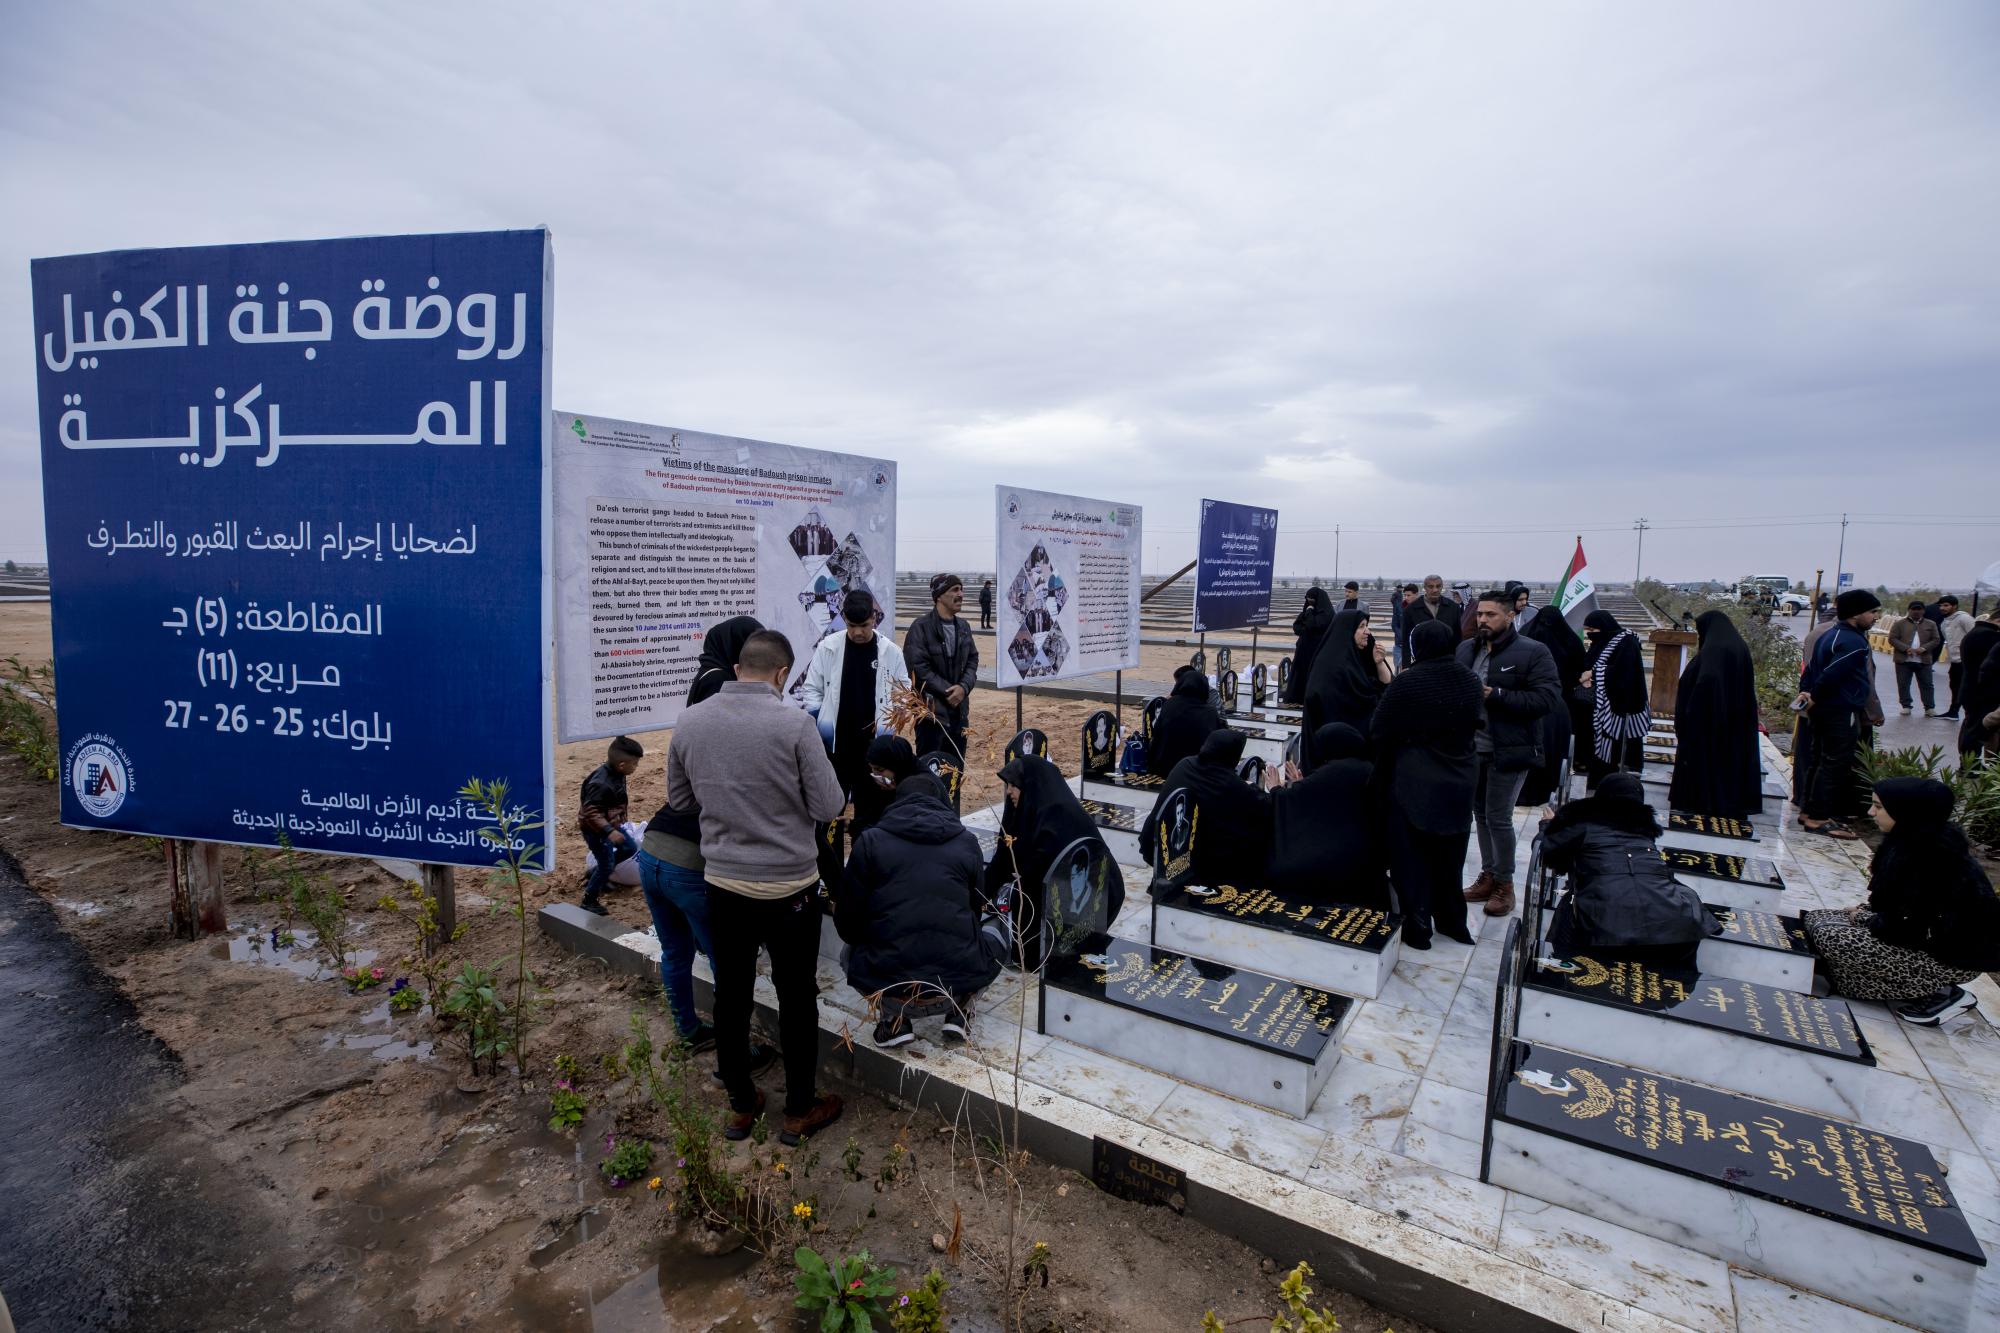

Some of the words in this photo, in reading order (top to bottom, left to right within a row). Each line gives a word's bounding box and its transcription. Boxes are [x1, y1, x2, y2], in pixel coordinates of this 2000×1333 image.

[44, 285, 208, 372] الكفيل
[229, 282, 332, 360] جنة
[353, 277, 526, 360] روضة
[662, 456, 691, 470] Victims
[693, 461, 701, 471] of
[703, 462, 715, 472] the
[716, 465, 749, 476] massacre
[750, 467, 758, 477] of
[759, 468, 786, 480] Badoush
[787, 472, 807, 482] prison
[590, 516, 614, 524] release
[620, 518, 645, 526] number
[622, 506, 649, 514] terrorist
[652, 509, 670, 517] gangs
[673, 509, 695, 517] headed
[88, 520, 176, 556] والتطرف
[183, 521, 237, 557] المقبور
[247, 522, 310, 555] البعث
[321, 522, 382, 561] إجرام
[392, 523, 476, 559] لضحايا
[590, 528, 605, 536] who
[606, 530, 630, 538] oppose
[648, 530, 687, 541] intellectually
[612, 541, 632, 549] bunch
[641, 542, 668, 550] criminals
[591, 554, 620, 562] separate
[639, 554, 672, 563] distinguish
[591, 565, 617, 574] religion
[618, 565, 630, 573] and
[631, 566, 645, 574] sect,
[591, 577, 599, 585] of
[623, 577, 647, 586] al-Bayt,
[613, 589, 625, 597] but
[592, 602, 612, 610] reeds,
[196, 596, 227, 637] (5)
[237, 602, 381, 635] المقاطعة:
[592, 613, 624, 621] devoured
[635, 612, 663, 620] ferocious
[593, 626, 604, 634] the
[673, 622, 686, 630] until
[614, 636, 639, 644] remains
[649, 633, 691, 644] approximately
[594, 650, 609, 658] than
[632, 659, 645, 667] holy
[198, 648, 237, 688] (11)
[594, 674, 605, 682] the
[606, 670, 654, 680] Documentation
[662, 666, 689, 675] Extremist
[247, 663, 340, 694] مربع:
[612, 685, 630, 693] grave
[650, 680, 670, 688] victims
[595, 697, 608, 705] and
[609, 695, 638, 704] terrorism
[661, 688, 687, 698] historical
[165, 700, 191, 728] 27
[216, 704, 248, 732] 26
[273, 707, 303, 736] 25
[595, 710, 607, 718] the
[607, 707, 629, 717] people
[313, 710, 391, 750] بلوك:
[78, 746, 97, 762] ADEEM
[98, 746, 106, 755] AL
[107, 752, 120, 766] ARD
[376, 795, 420, 817] الأرض
[426, 799, 461, 821] أديم
[233, 810, 284, 830] الحديثة
[289, 814, 360, 837] النموذجية
[365, 822, 422, 842] الأشرف
[428, 828, 474, 848] النجف
[1860, 1170, 1879, 1181] 10
[1884, 1170, 1905, 1183] 16
[1866, 1186, 1884, 1194] 6
[1891, 1188, 1912, 1199] 5
[1871, 1198, 1896, 1223] 2014
[1898, 1204, 1928, 1233] 2023
